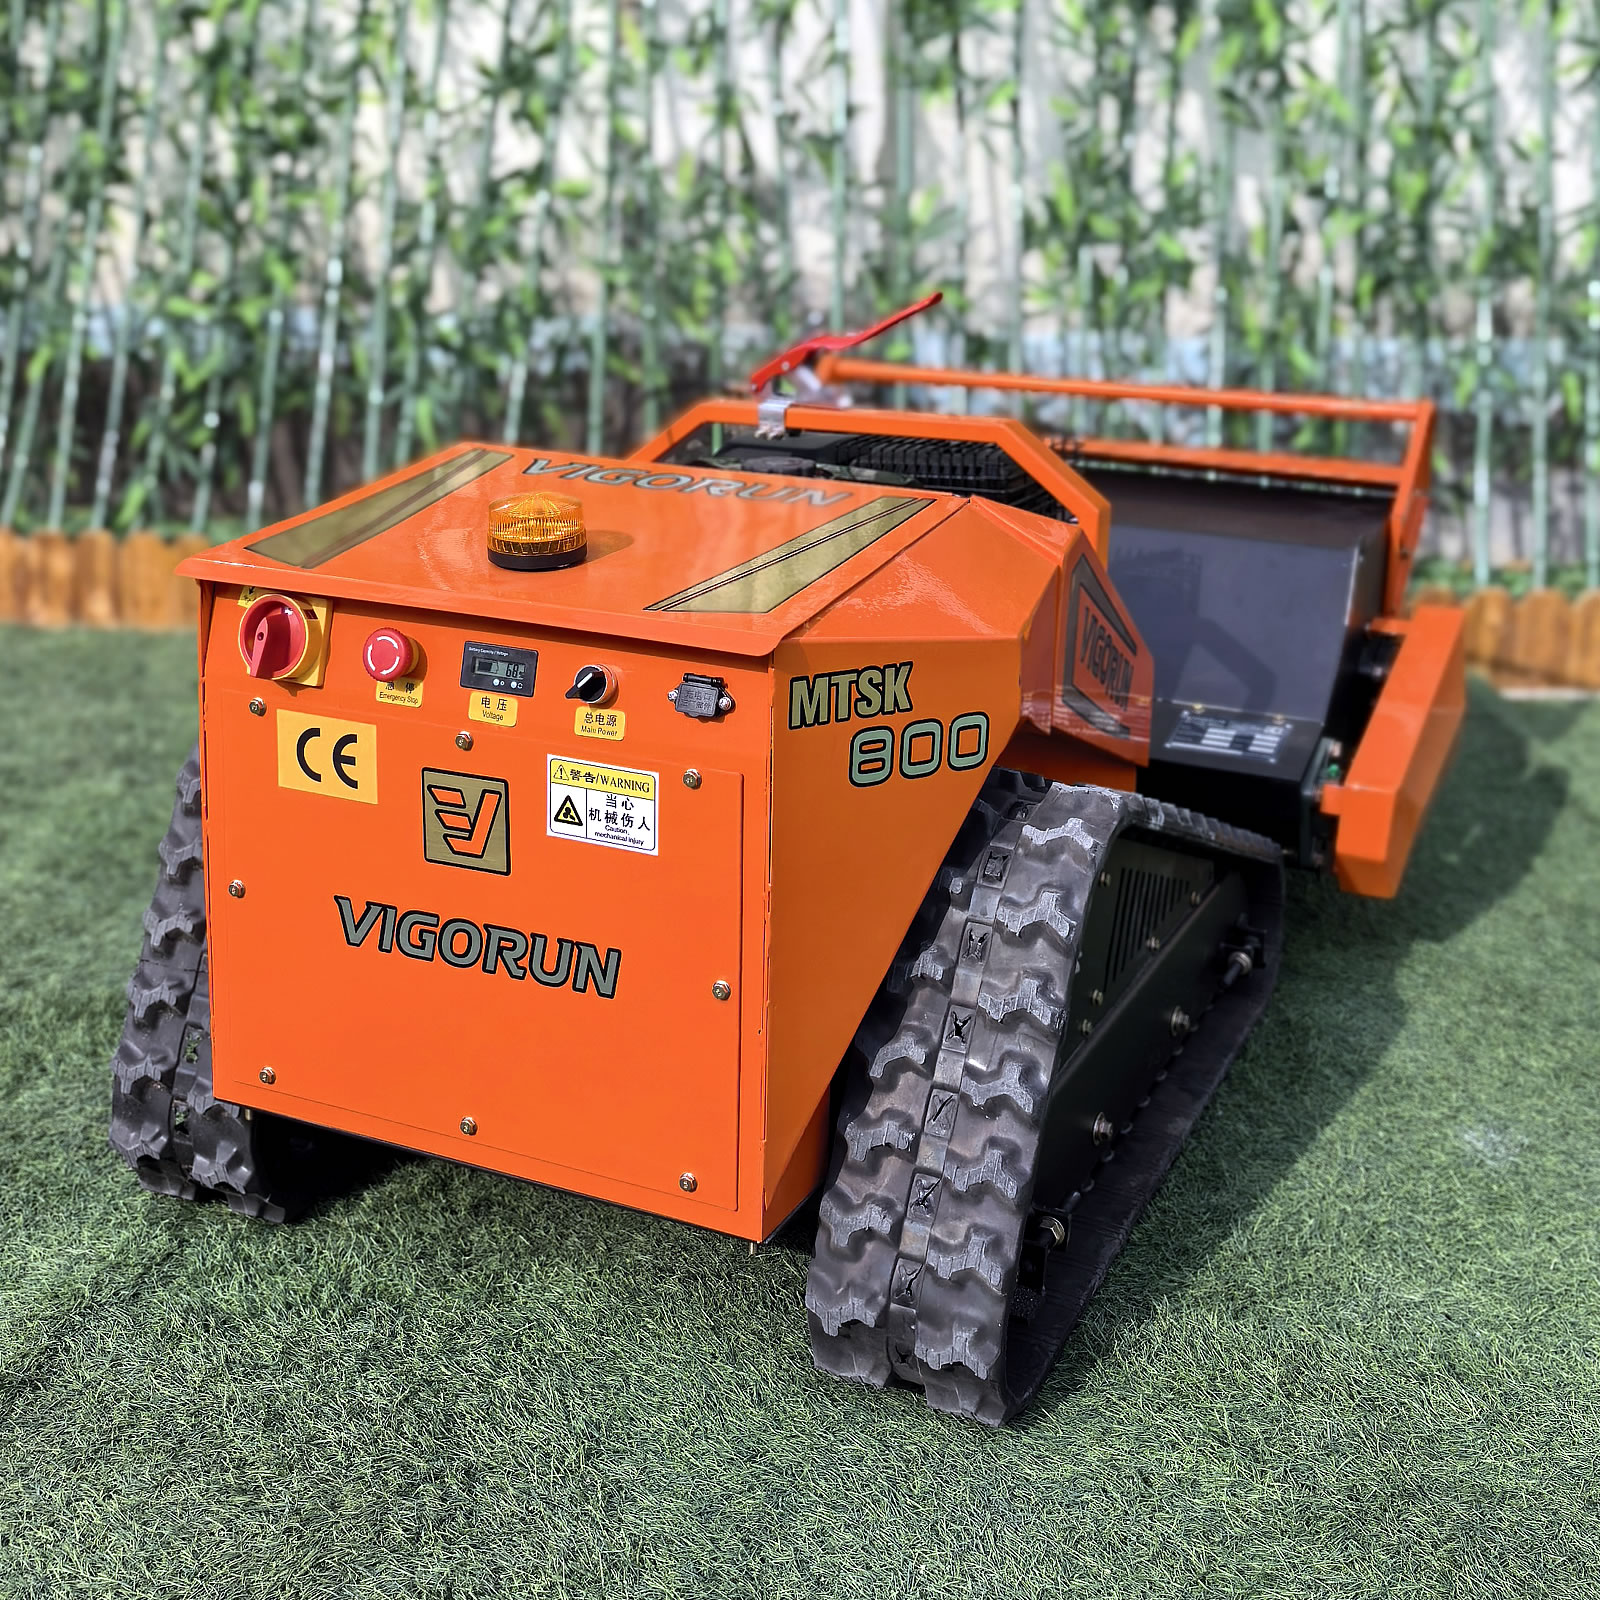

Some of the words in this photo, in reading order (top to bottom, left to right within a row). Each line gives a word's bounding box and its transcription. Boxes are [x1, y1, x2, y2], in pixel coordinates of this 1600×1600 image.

[522, 458, 853, 507] VIGORUN
[1080, 605, 1134, 712] VIGORUN
[379, 691, 406, 703] Emergency
[406, 695, 419, 705] Stop
[481, 696, 507, 711] 电压
[788, 661, 913, 730] MTSK
[482, 710, 504, 721] Voltage
[584, 712, 617, 727] 总电源
[581, 724, 597, 734] Main
[597, 727, 618, 736] Power
[296, 728, 358, 789] CE
[848, 711, 989, 787] 800
[589, 807, 651, 831] 机械伤人
[594, 831, 628, 842] mechanical
[628, 837, 645, 846] injury
[333, 895, 622, 999] VIGORUN
